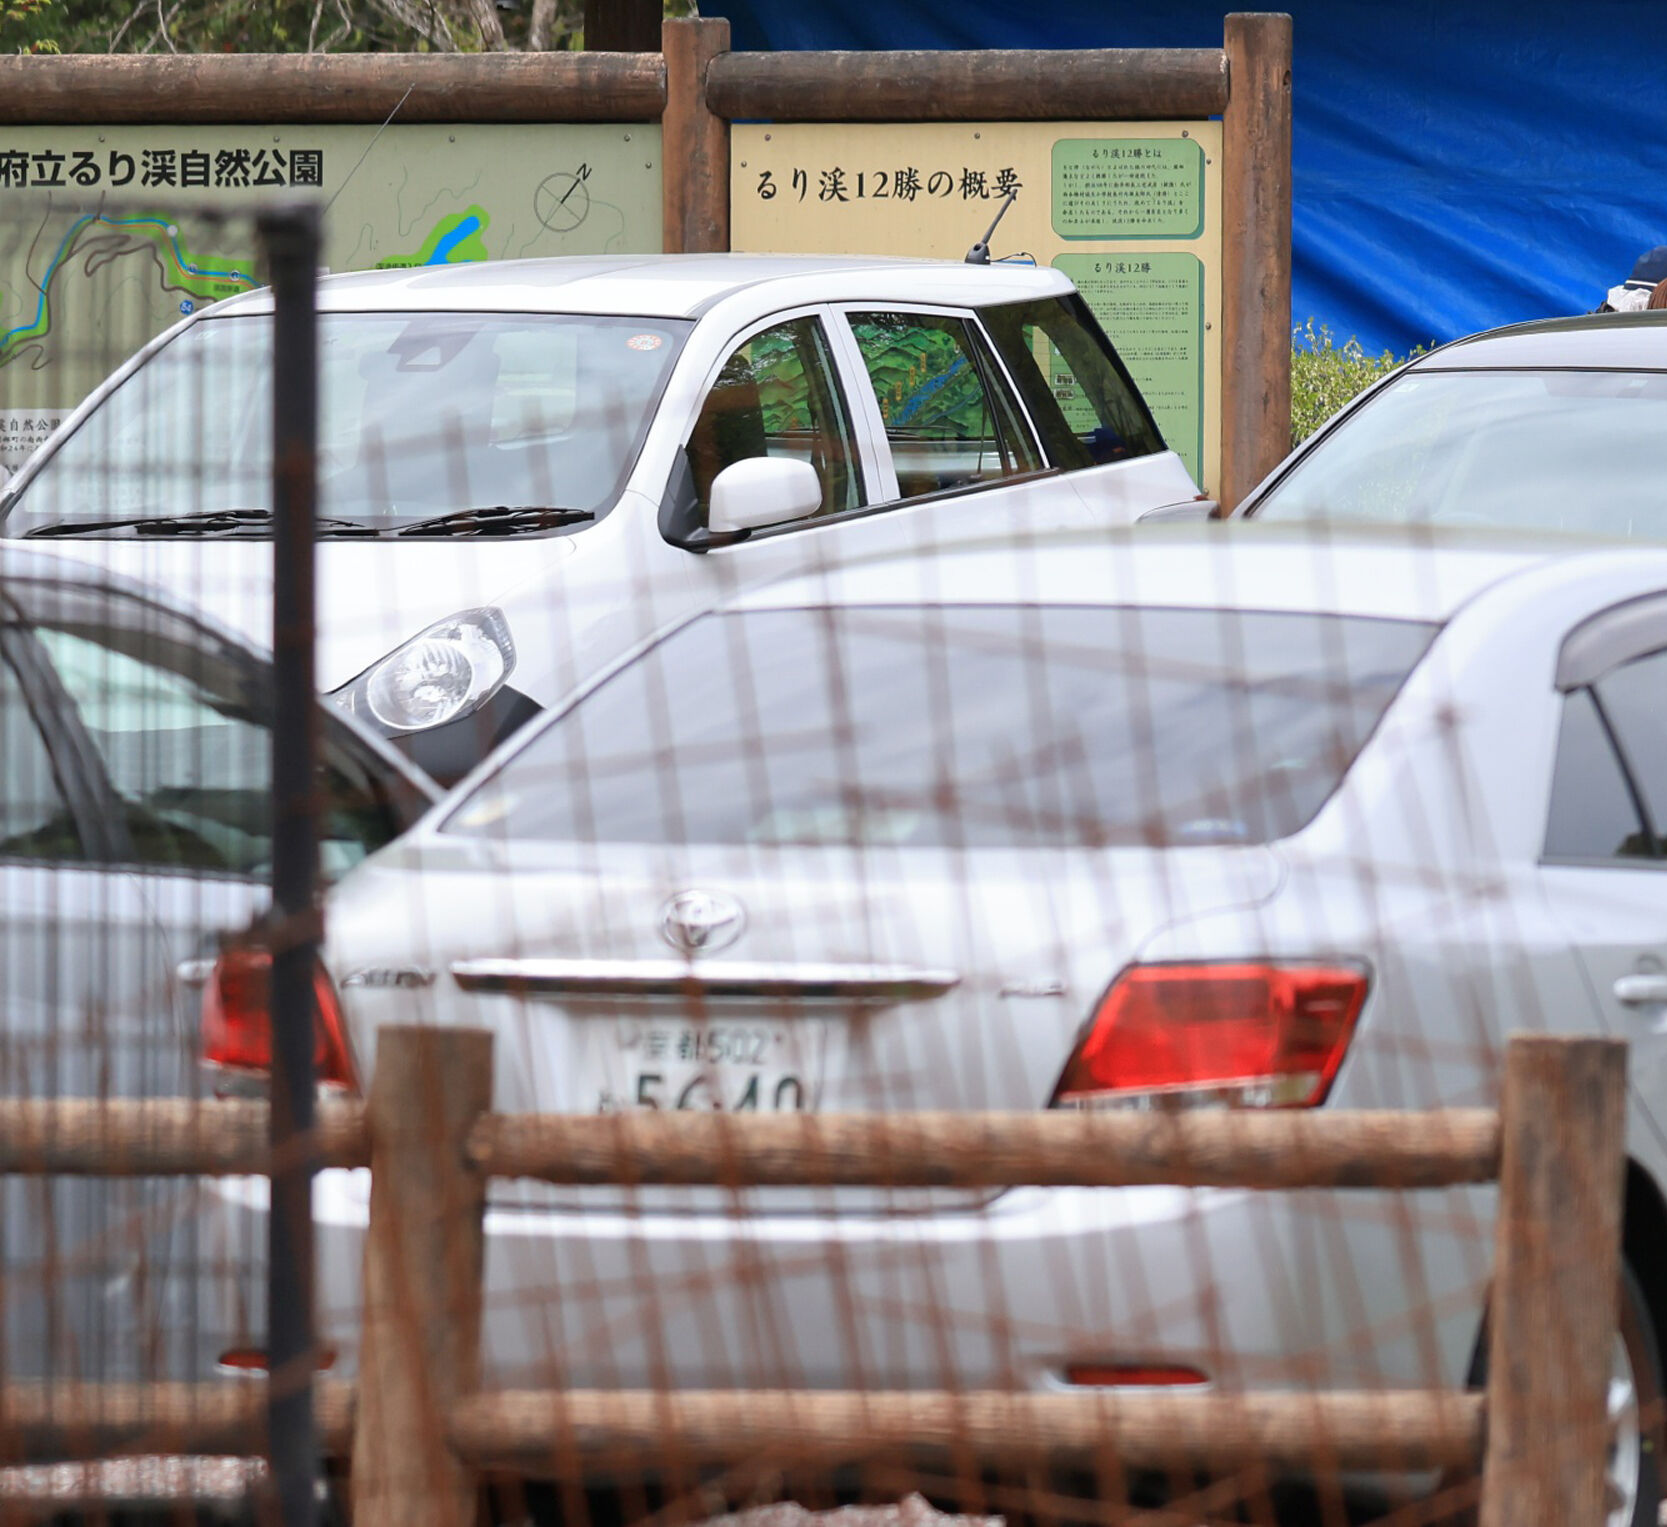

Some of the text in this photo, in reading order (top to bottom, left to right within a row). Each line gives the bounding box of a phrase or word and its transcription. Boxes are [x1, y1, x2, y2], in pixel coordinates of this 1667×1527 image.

[0, 149, 324, 189] 府立るり渓自然公園
[756, 166, 1024, 203] るり渓12勝の概要
[1094, 262, 1152, 274] るり渓12勝
